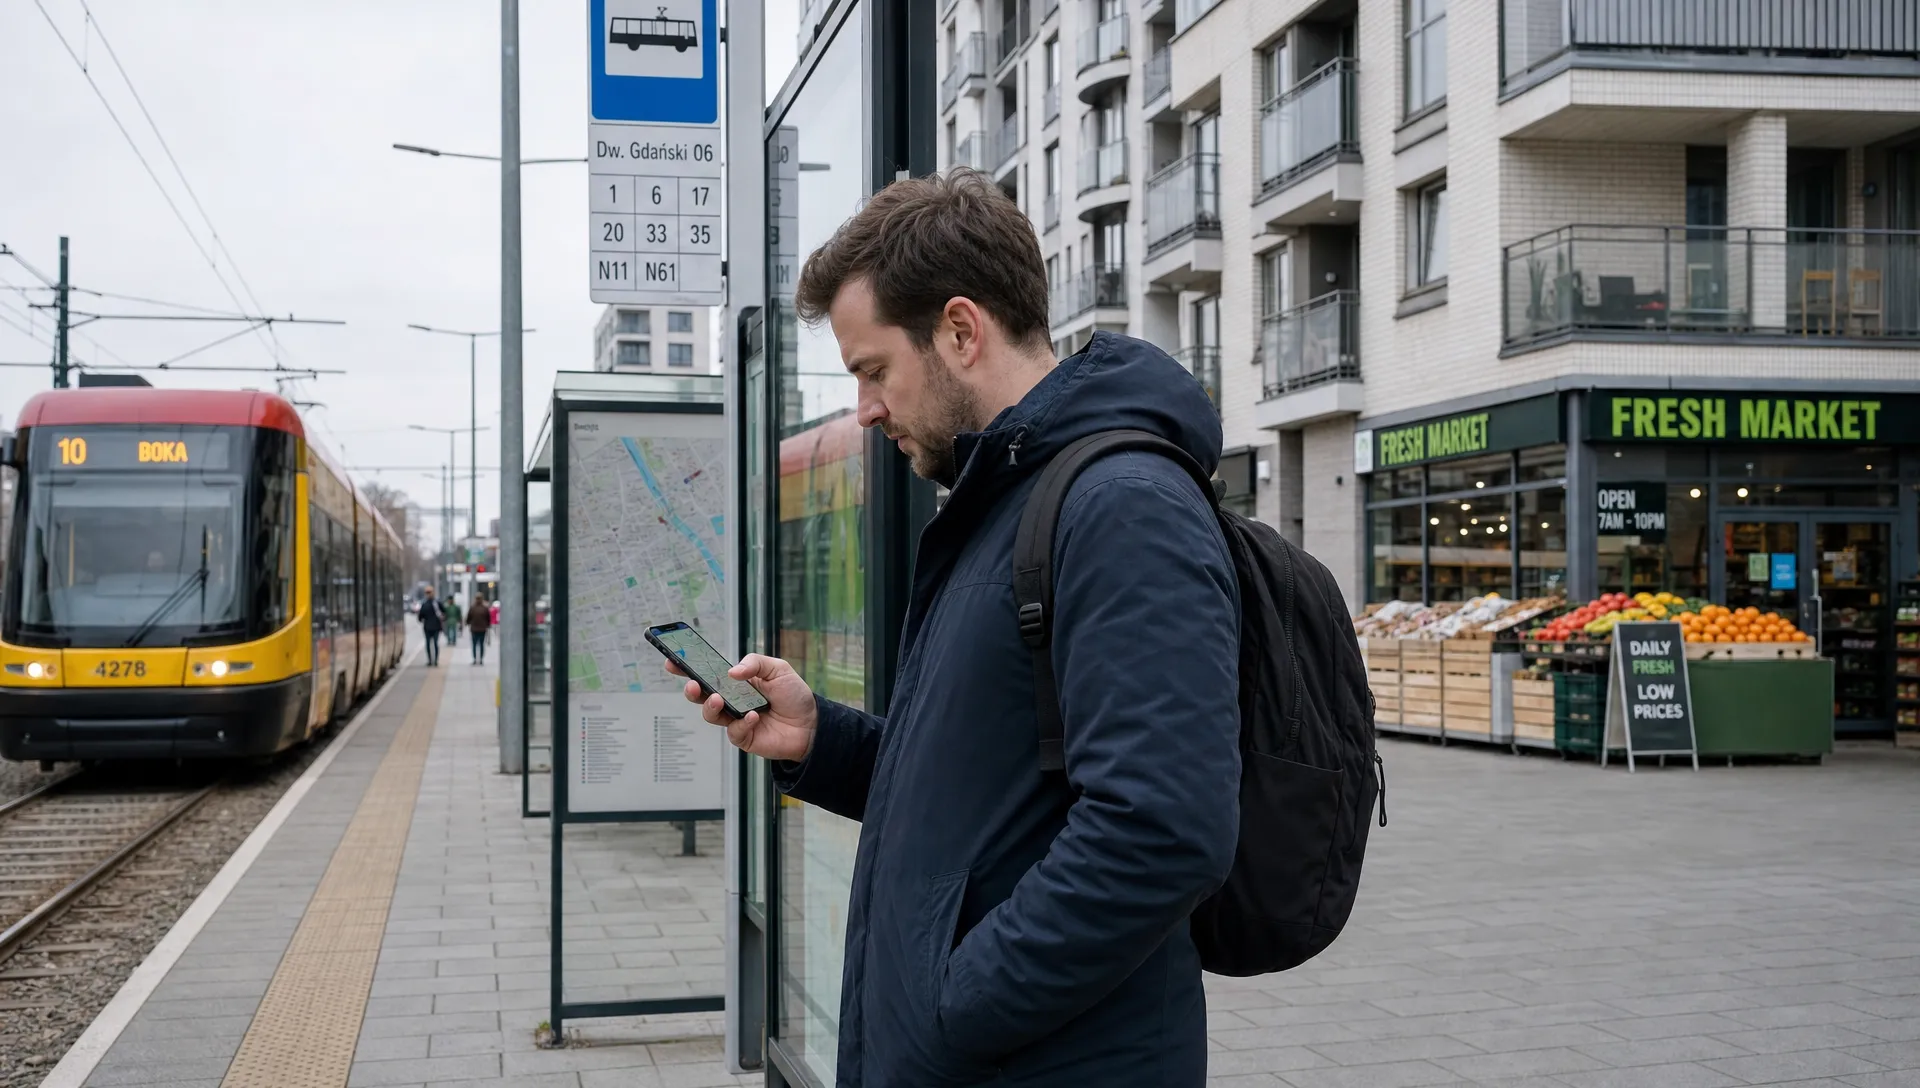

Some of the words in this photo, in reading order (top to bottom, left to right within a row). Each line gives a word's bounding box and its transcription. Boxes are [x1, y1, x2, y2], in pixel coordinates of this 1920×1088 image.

[597, 141, 624, 158] Dw.
[630, 142, 688, 161] Gdański
[693, 144, 713, 162] 06
[609, 184, 617, 203] 1
[652, 185, 662, 204] 6
[692, 187, 709, 206] 17
[603, 222, 624, 242] 20
[646, 223, 667, 243] 33
[690, 224, 711, 244] 35
[599, 261, 628, 281] N11
[645, 262, 676, 282] N61
[1611, 397, 1726, 438] FRESH
[1740, 399, 1881, 440] MARKET
[1380, 427, 1424, 466] FRESH
[1428, 412, 1490, 458] MARKET
[58, 437, 87, 465] 10
[138, 441, 189, 463] BOKA
[1598, 489, 1636, 510] OPEN
[1598, 512, 1624, 530] 7AM
[1634, 513, 1665, 530] 10PM
[1630, 640, 1671, 656] DAILY
[94, 660, 147, 678] 4278
[1632, 660, 1675, 675] FRESH
[1637, 683, 1675, 700] LOW
[1633, 703, 1684, 719] PRICES
